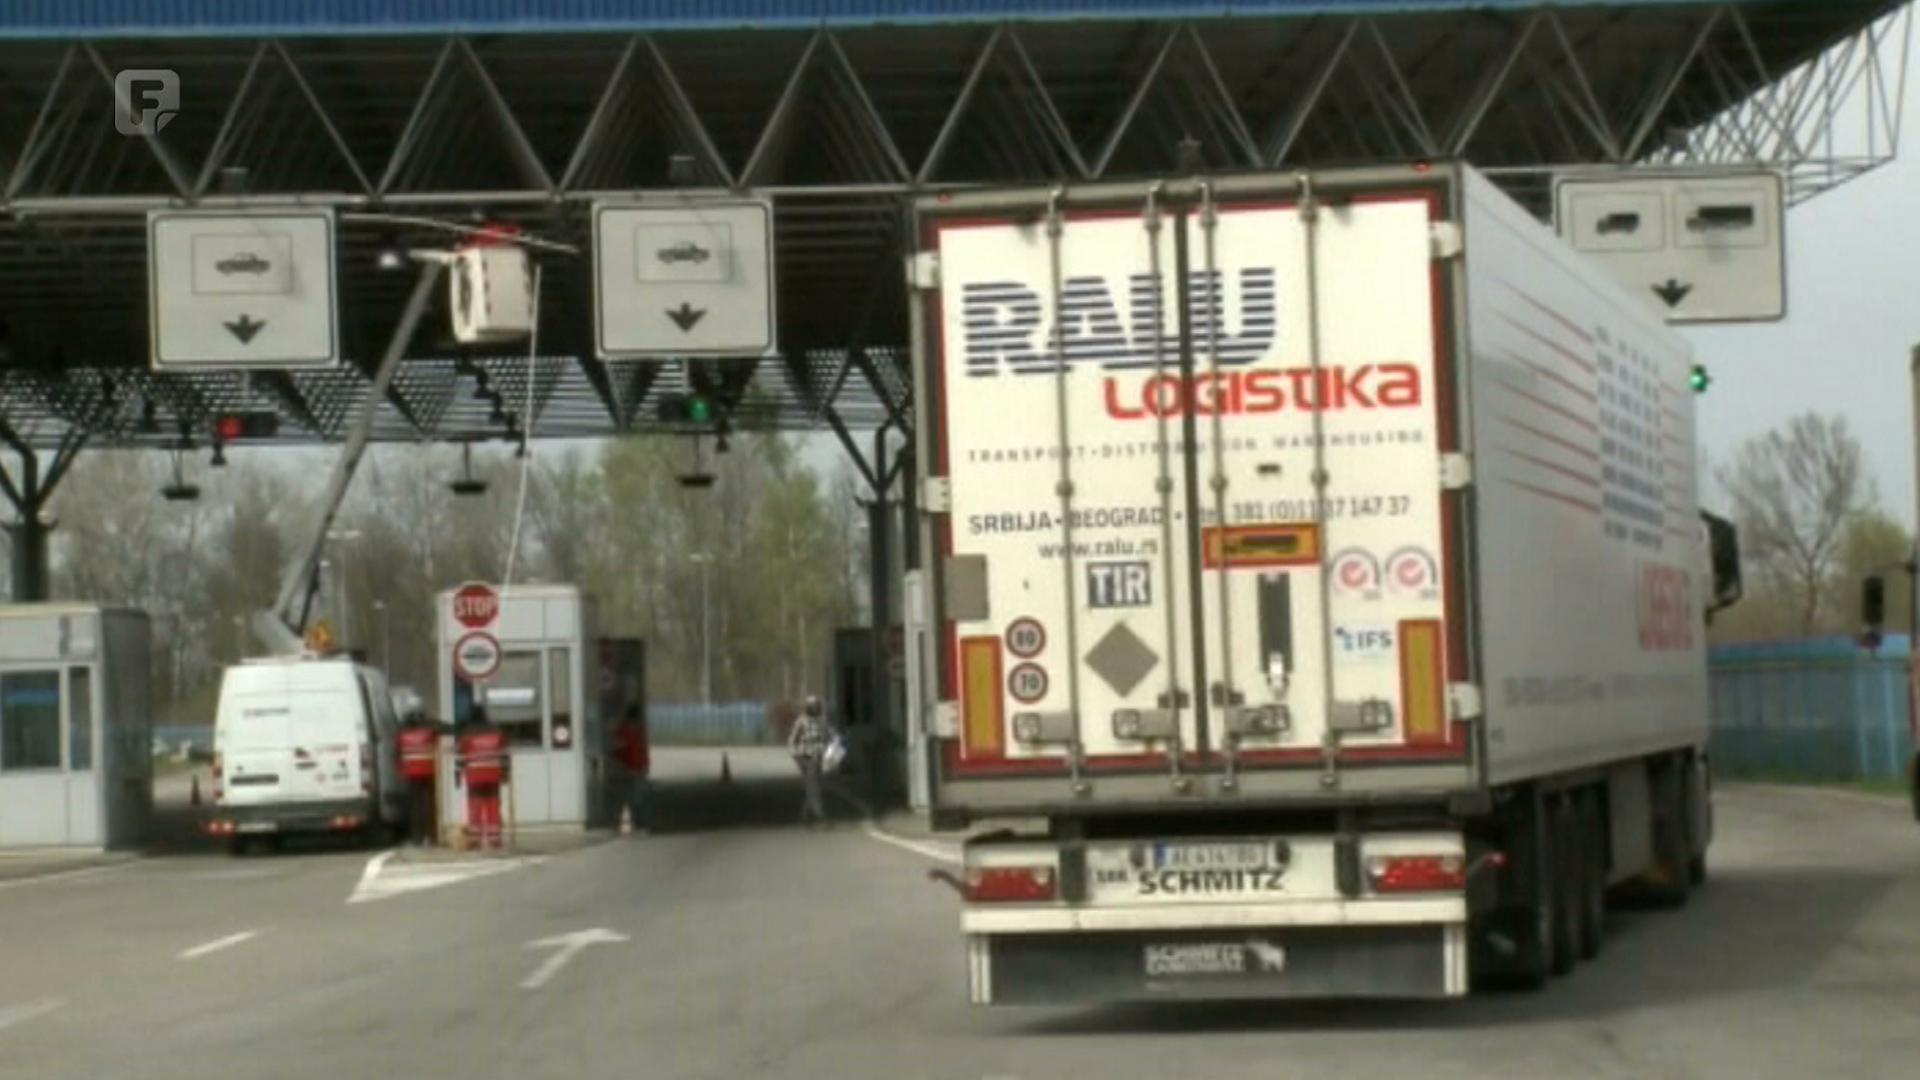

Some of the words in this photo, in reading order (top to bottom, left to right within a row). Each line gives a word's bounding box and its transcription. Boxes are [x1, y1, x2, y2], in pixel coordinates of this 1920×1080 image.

[962, 268, 1276, 377] RALU
[969, 446, 1085, 461] TRANSPOT
[1091, 566, 1148, 604] TIR
[455, 596, 498, 616] STOP
[1357, 631, 1392, 651] IFS
[1138, 869, 1285, 894] SCHMITZ
